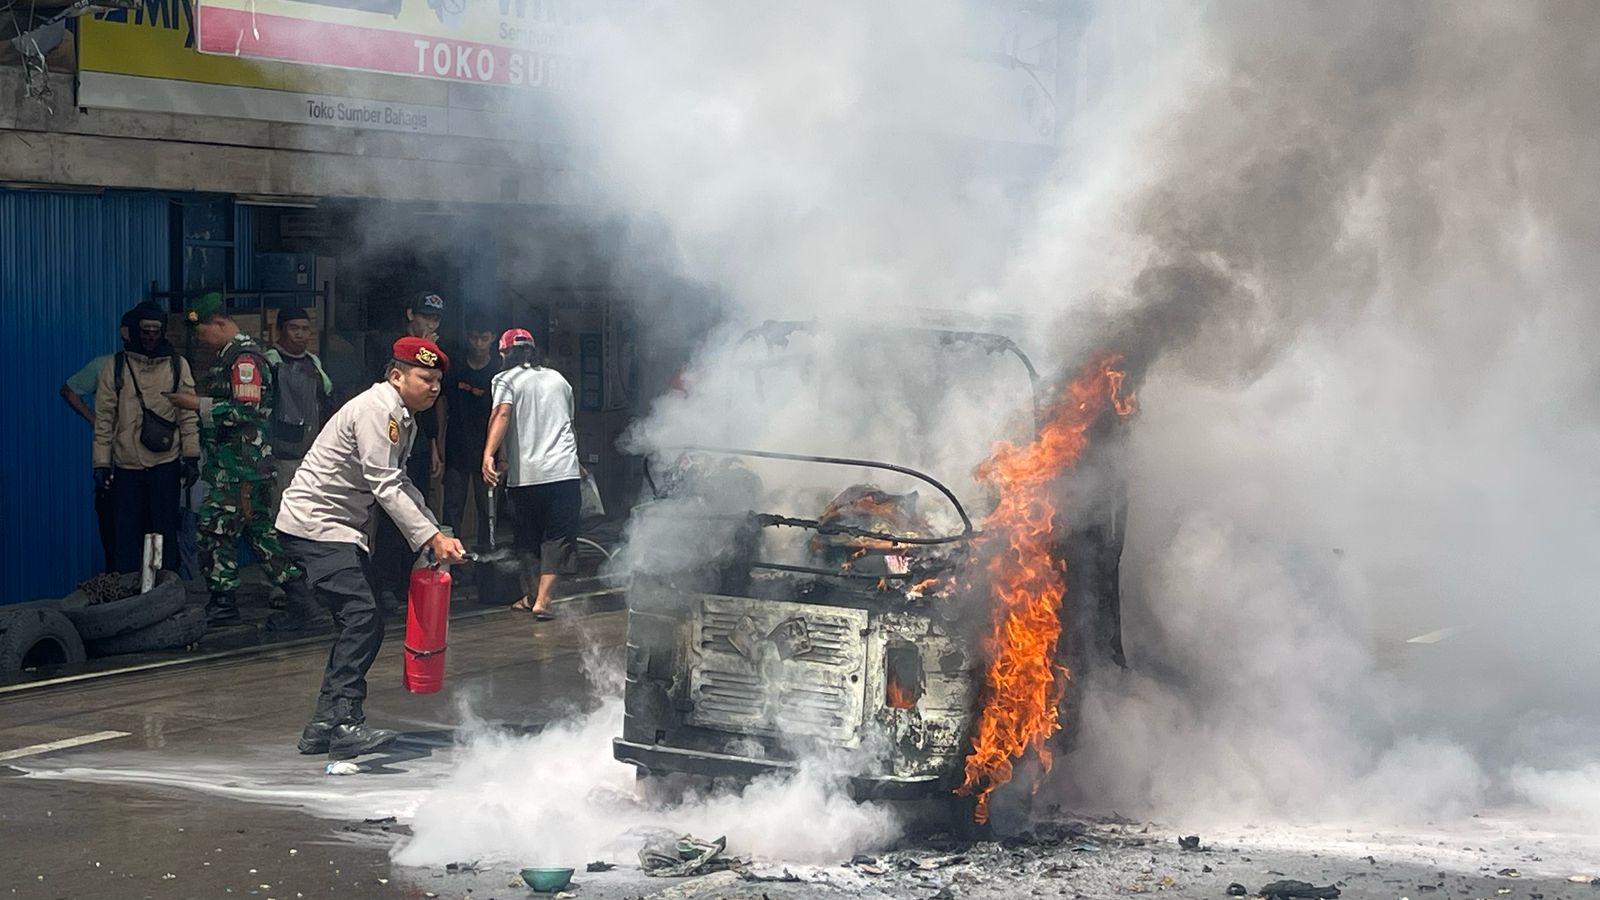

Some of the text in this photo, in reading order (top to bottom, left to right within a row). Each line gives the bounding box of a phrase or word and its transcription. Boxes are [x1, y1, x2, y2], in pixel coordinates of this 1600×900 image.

[414, 40, 494, 81] TOKO
[307, 100, 428, 132] Toko Sumber Bahagia
